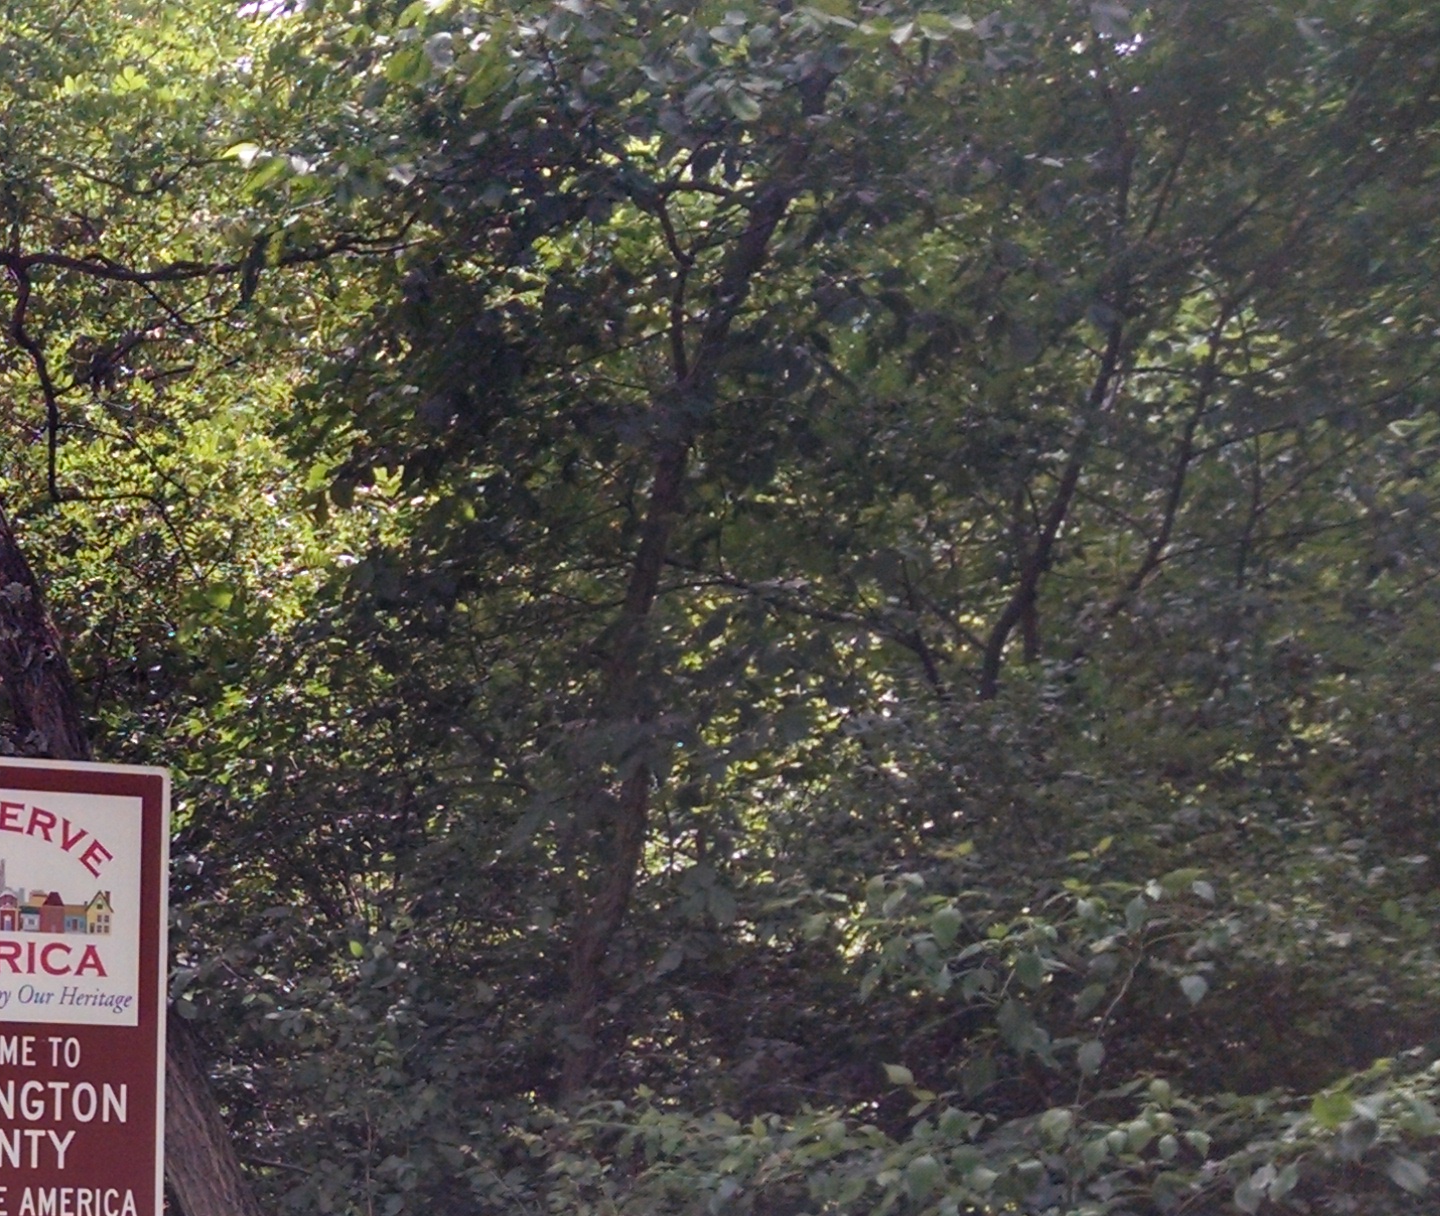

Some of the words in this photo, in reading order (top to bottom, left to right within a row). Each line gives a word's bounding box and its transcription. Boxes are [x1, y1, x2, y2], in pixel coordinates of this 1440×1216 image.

[18, 984, 55, 1005] Our
[59, 986, 133, 1012] Heritage
[48, 1037, 81, 1068] TO
